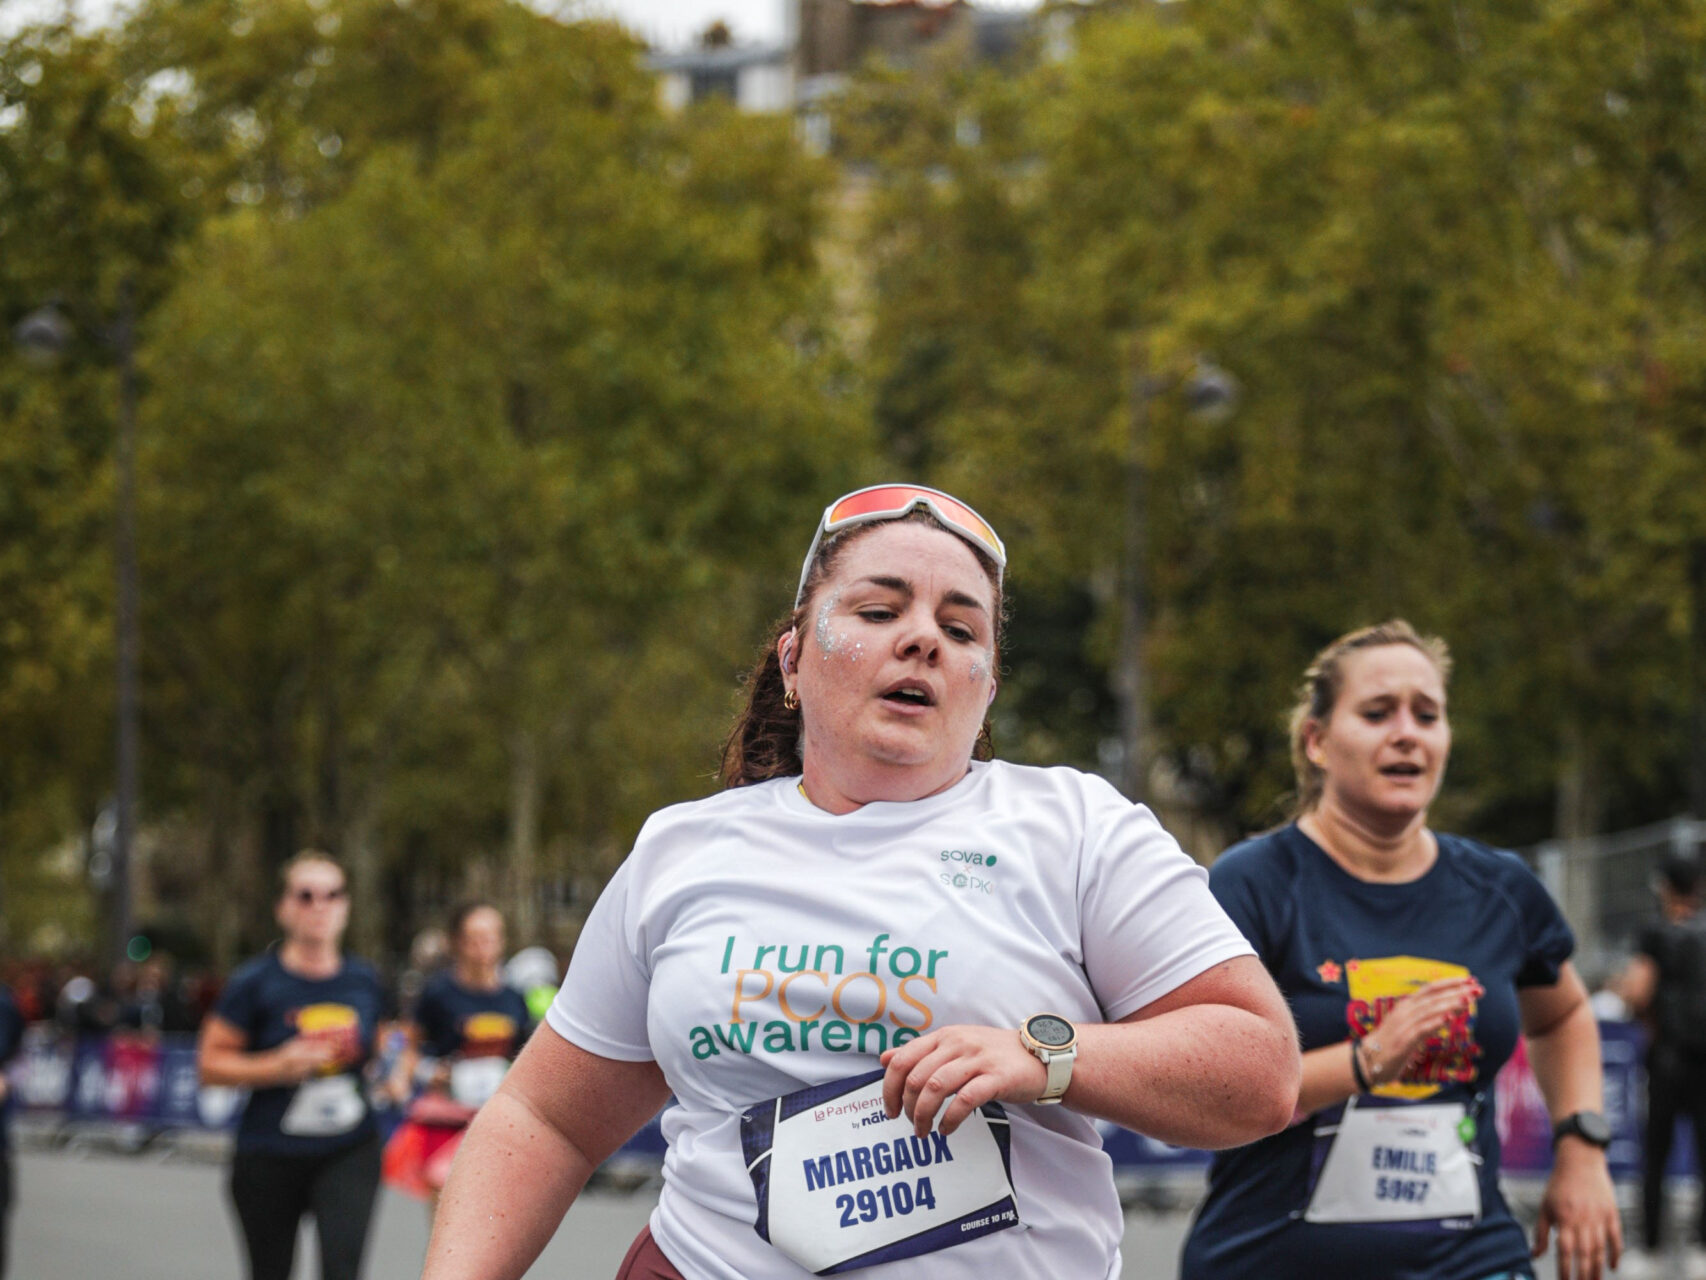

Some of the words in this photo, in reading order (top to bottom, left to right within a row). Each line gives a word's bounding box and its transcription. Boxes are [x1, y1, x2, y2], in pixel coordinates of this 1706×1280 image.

[940, 850, 983, 865] sova
[720, 936, 736, 974] I
[753, 943, 845, 975] run
[866, 934, 949, 979] for
[729, 969, 938, 1032] PCOS
[689, 1018, 922, 1061] awarene
[861, 1109, 890, 1126] nāk
[803, 1130, 953, 1192] MARGAUX
[1372, 1146, 1437, 1175] EMILIE
[836, 1176, 936, 1228] 29104
[961, 1217, 990, 1232] COURSE
[991, 1214, 1000, 1223] 10
